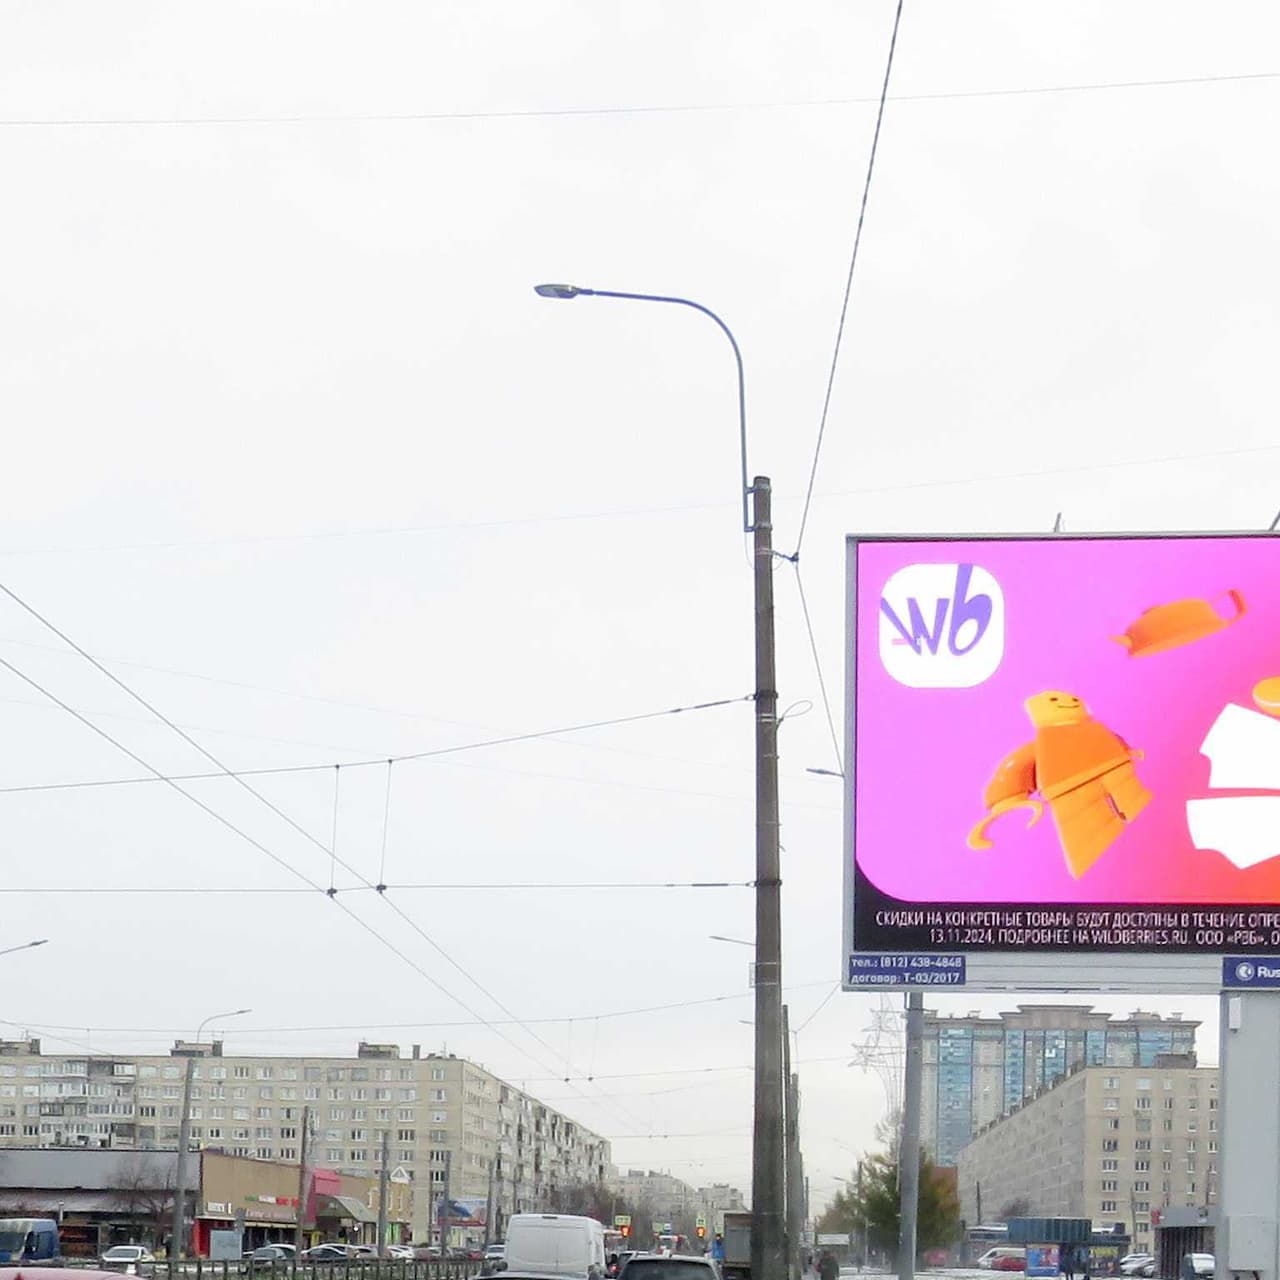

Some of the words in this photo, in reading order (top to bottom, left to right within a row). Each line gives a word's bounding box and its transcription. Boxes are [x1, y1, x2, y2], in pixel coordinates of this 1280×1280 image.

[876, 912, 924, 928] СКИДКИ
[926, 912, 943, 926] НА
[945, 912, 1022, 927] КОНКРЕТНЫЕ
[1025, 912, 1074, 927] ТОВАРЫ
[1076, 913, 1110, 928] БУДУТ
[1112, 913, 1178, 929] ДОСТУПНЫ
[1181, 913, 1190, 928] В
[1192, 913, 1246, 928] ТЕЧЕНИЕ
[998, 929, 1070, 944] ПОДРОБНЕЕ
[1072, 929, 1089, 944] НА
[1195, 930, 1224, 945] ООО
[880, 956, 908, 968] (812)
[910, 957, 962, 967] 438-4848
[851, 975, 900, 984] договор:
